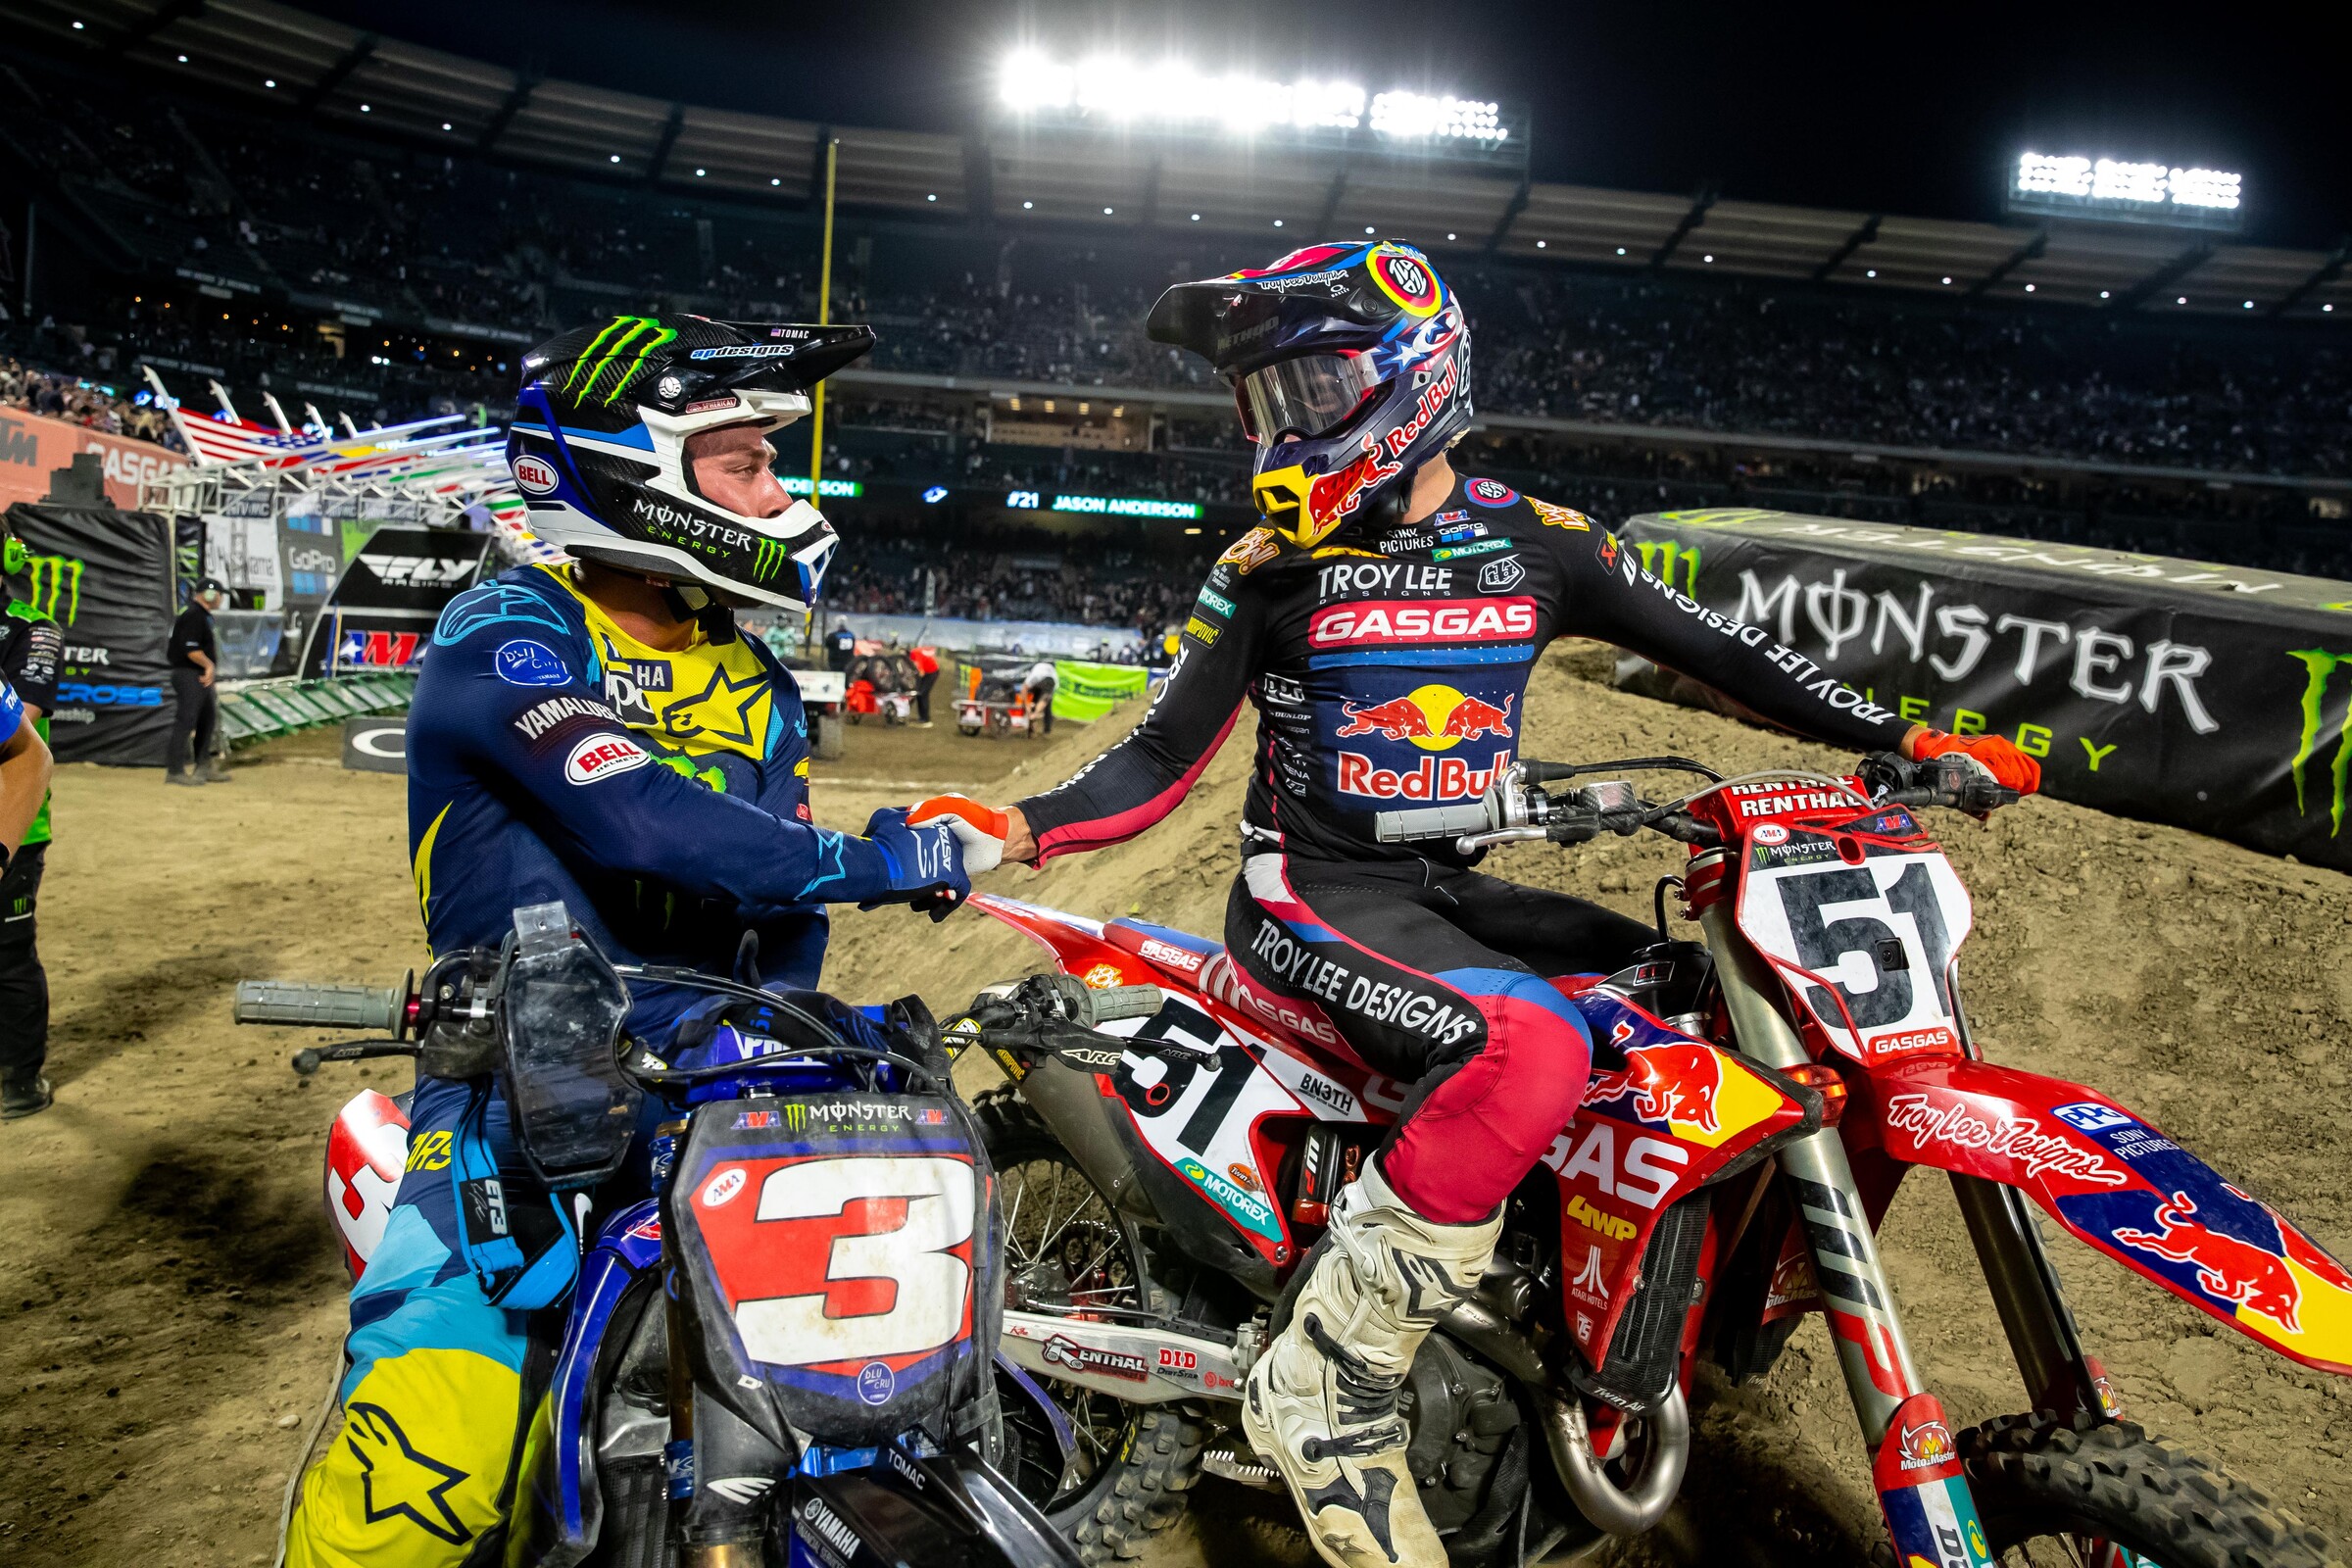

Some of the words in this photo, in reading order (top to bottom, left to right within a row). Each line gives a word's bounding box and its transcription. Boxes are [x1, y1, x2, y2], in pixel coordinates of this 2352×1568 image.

[780, 328, 809, 339] TOMAC
[690, 345, 794, 360] apdesigns
[1387, 395, 1431, 459] Red
[1426, 354, 1459, 416] Bull
[517, 465, 551, 487] BELL
[1006, 492, 1039, 509] #21
[1052, 495, 1105, 514] JASON
[1106, 498, 1196, 518] ANDERSON
[1387, 528, 1418, 539] SONY
[1438, 522, 1484, 535] GoPro
[648, 526, 731, 558] ENERGY
[1379, 536, 1434, 554] PICTURES
[1452, 538, 1508, 557] MOTOREX
[288, 547, 336, 573] GoPro
[1318, 564, 1401, 599] TROY
[1405, 564, 1452, 590] LEE
[1319, 590, 1451, 605] DESIGNS
[1314, 604, 1534, 643] GASGAS
[339, 630, 429, 667] AM
[1640, 568, 1767, 648] DESIGNS
[1765, 643, 1822, 683] LEE
[1805, 679, 1895, 725] TROY
[1274, 711, 1312, 721] DUNLOP
[1842, 681, 2119, 773] ERGY
[576, 743, 640, 773] BELL
[596, 756, 640, 773] HELMETS
[1337, 750, 1434, 801] Red
[1740, 791, 1862, 817] RENTHAL
[1761, 829, 1783, 839] AMA
[1875, 813, 1911, 832] AMA
[1785, 853, 1831, 863] ENERGY
[1140, 939, 1202, 971] GASGAS
[1775, 860, 1954, 1030] 51
[1250, 917, 1311, 986] TROY
[1302, 956, 1349, 1003] LEE
[1345, 975, 1477, 1046] DESIGNS
[1874, 1029, 1948, 1054] GASGAS
[1061, 1048, 1122, 1065] ARC
[732, 1110, 782, 1130] AMA
[829, 1124, 900, 1133] ENERGY
[1887, 1093, 1944, 1149] Troy
[1936, 1102, 1990, 1148] Lee
[1987, 1117, 2128, 1186] Designs
[2110, 1128, 2150, 1144] SONY
[2114, 1139, 2180, 1160] PICTURES
[712, 1173, 741, 1202] AMA
[1230, 1166, 1249, 1183] Twin
[1203, 1174, 1270, 1226] MOTOREX
[737, 1155, 975, 1365] 3
[1571, 1287, 1588, 1303] ATARI
[1587, 1294, 1608, 1311] HOTELS
[1044, 1334, 1147, 1372] RENTHAL
[1592, 1386, 1627, 1405] Twin
[1627, 1399, 1647, 1413] Air
[888, 1447, 927, 1491] TOMAC
[813, 1509, 861, 1560] YAMAHA
